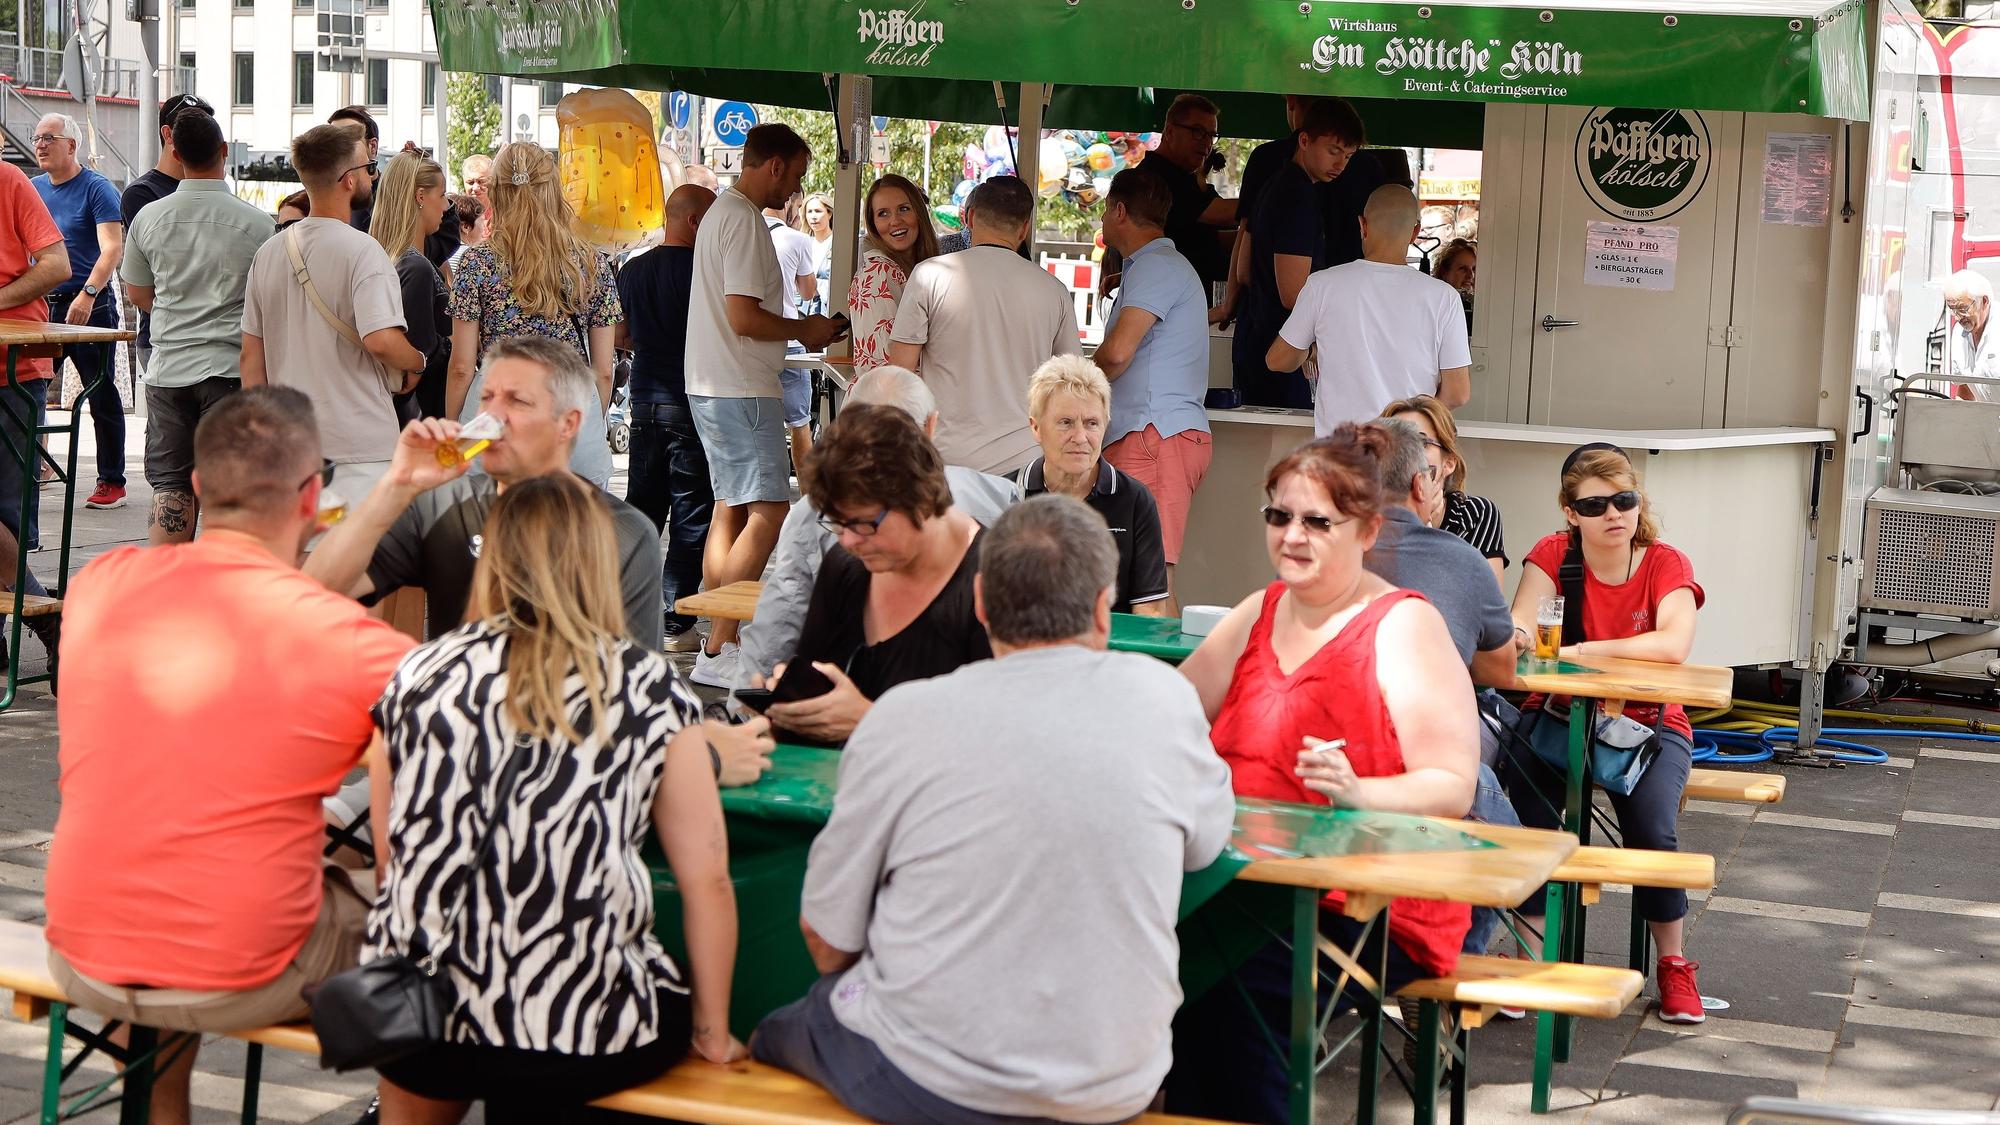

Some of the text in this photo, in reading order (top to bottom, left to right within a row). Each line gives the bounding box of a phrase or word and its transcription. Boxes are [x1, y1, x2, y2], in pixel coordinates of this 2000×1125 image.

[857, 9, 945, 47] Päffgen
[1328, 17, 1398, 32] Wirtshaus
[865, 40, 937, 67] kölsch
[1500, 40, 1584, 80] Köln
[1464, 80, 1568, 98] Cateringservice
[1590, 116, 1700, 164] Päffgen
[1599, 157, 1689, 188] kölsch
[1637, 209, 1654, 217] 1883
[1604, 239, 1659, 251] PFAND PRO
[1601, 253, 1620, 262] GLAS
[1600, 264, 1664, 275] BIERGLASTRÄGER
